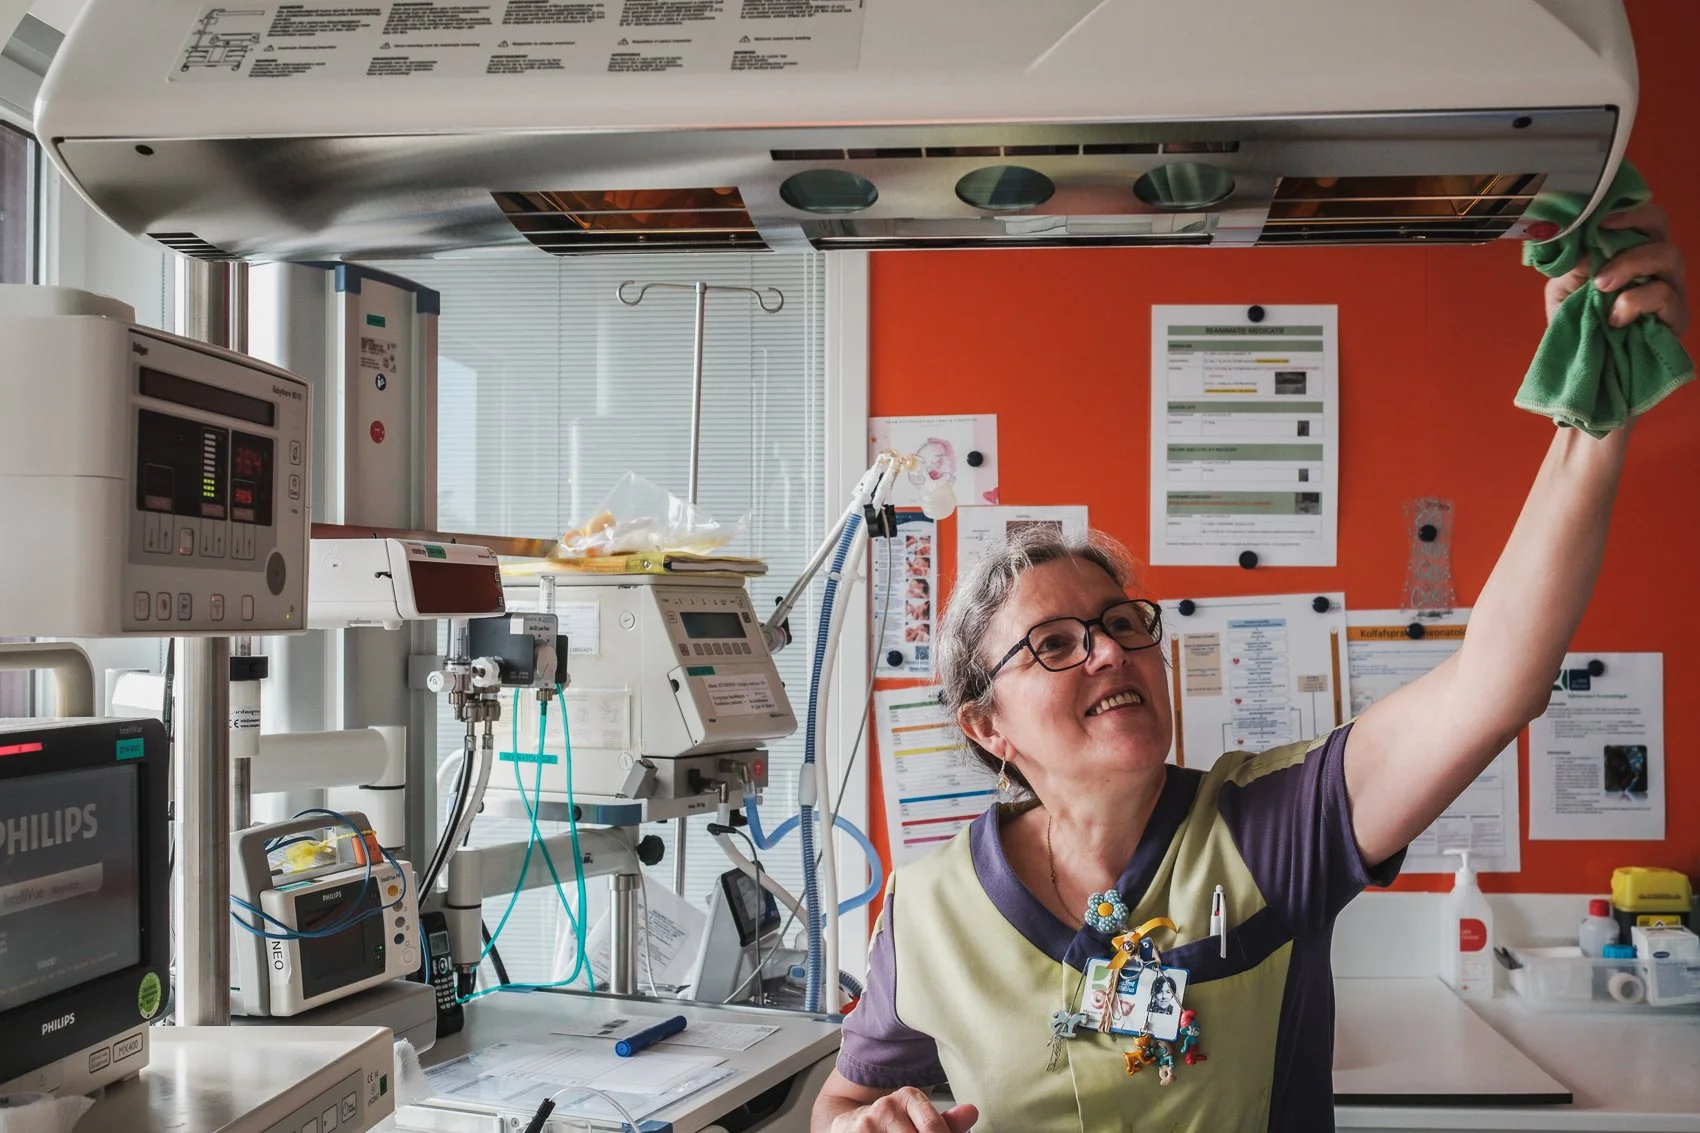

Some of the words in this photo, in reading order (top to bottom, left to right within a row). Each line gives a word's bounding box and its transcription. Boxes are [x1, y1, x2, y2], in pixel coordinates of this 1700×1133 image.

[322, 890, 342, 902] PHILIPS
[272, 941, 284, 971] NEO
[41, 1012, 76, 1036] PHILIPS
[118, 1039, 139, 1057] MX400
